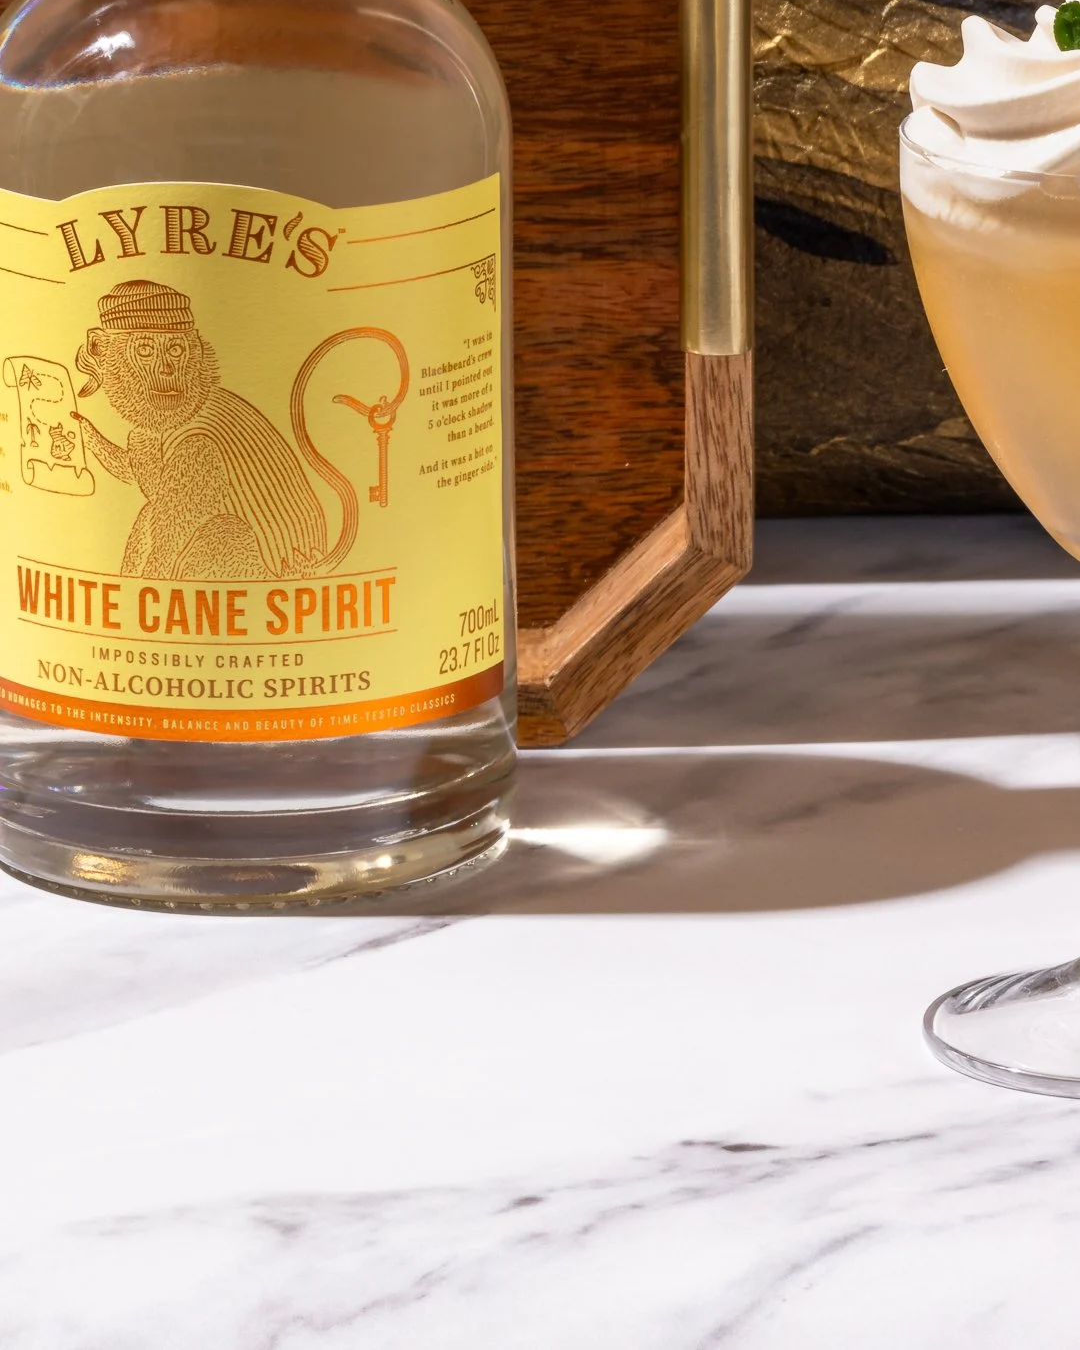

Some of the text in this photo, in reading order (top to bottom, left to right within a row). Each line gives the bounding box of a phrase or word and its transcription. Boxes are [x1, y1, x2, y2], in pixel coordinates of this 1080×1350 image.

[56, 205, 338, 278] LYRE'S
[472, 334, 485, 346] was
[421, 349, 493, 378] Blackbeard's crew
[419, 381, 443, 396] until
[452, 368, 481, 392] pointed
[432, 400, 439, 411] it
[442, 397, 458, 408] was
[460, 390, 480, 403] more
[481, 382, 488, 395] of
[428, 401, 493, 430] 5 o'clock shadow
[447, 430, 467, 442] than
[468, 427, 473, 436] a
[418, 444, 493, 475] And it was a bit on
[437, 477, 452, 488] the
[454, 468, 480, 487] ginger
[17, 564, 396, 637] WHITE CANE SPIRIT
[459, 598, 500, 638] 700mL
[91, 646, 304, 670] IMPOSSIBLY CRAFTED
[439, 641, 471, 675] 23.7
[487, 631, 500, 658] Oz
[37, 659, 372, 700] NON-ALCOHOLIC SPIRITS
[8, 690, 47, 712] HOMAGES
[50, 703, 62, 715] TO
[66, 706, 86, 720] THE
[162, 718, 219, 732] BALANCE
[225, 721, 250, 732] AND
[255, 719, 304, 731] BEAUTY
[309, 717, 324, 728] OF
[329, 706, 406, 726] TIME-TESTED
[409, 693, 456, 715] CLASSICS
